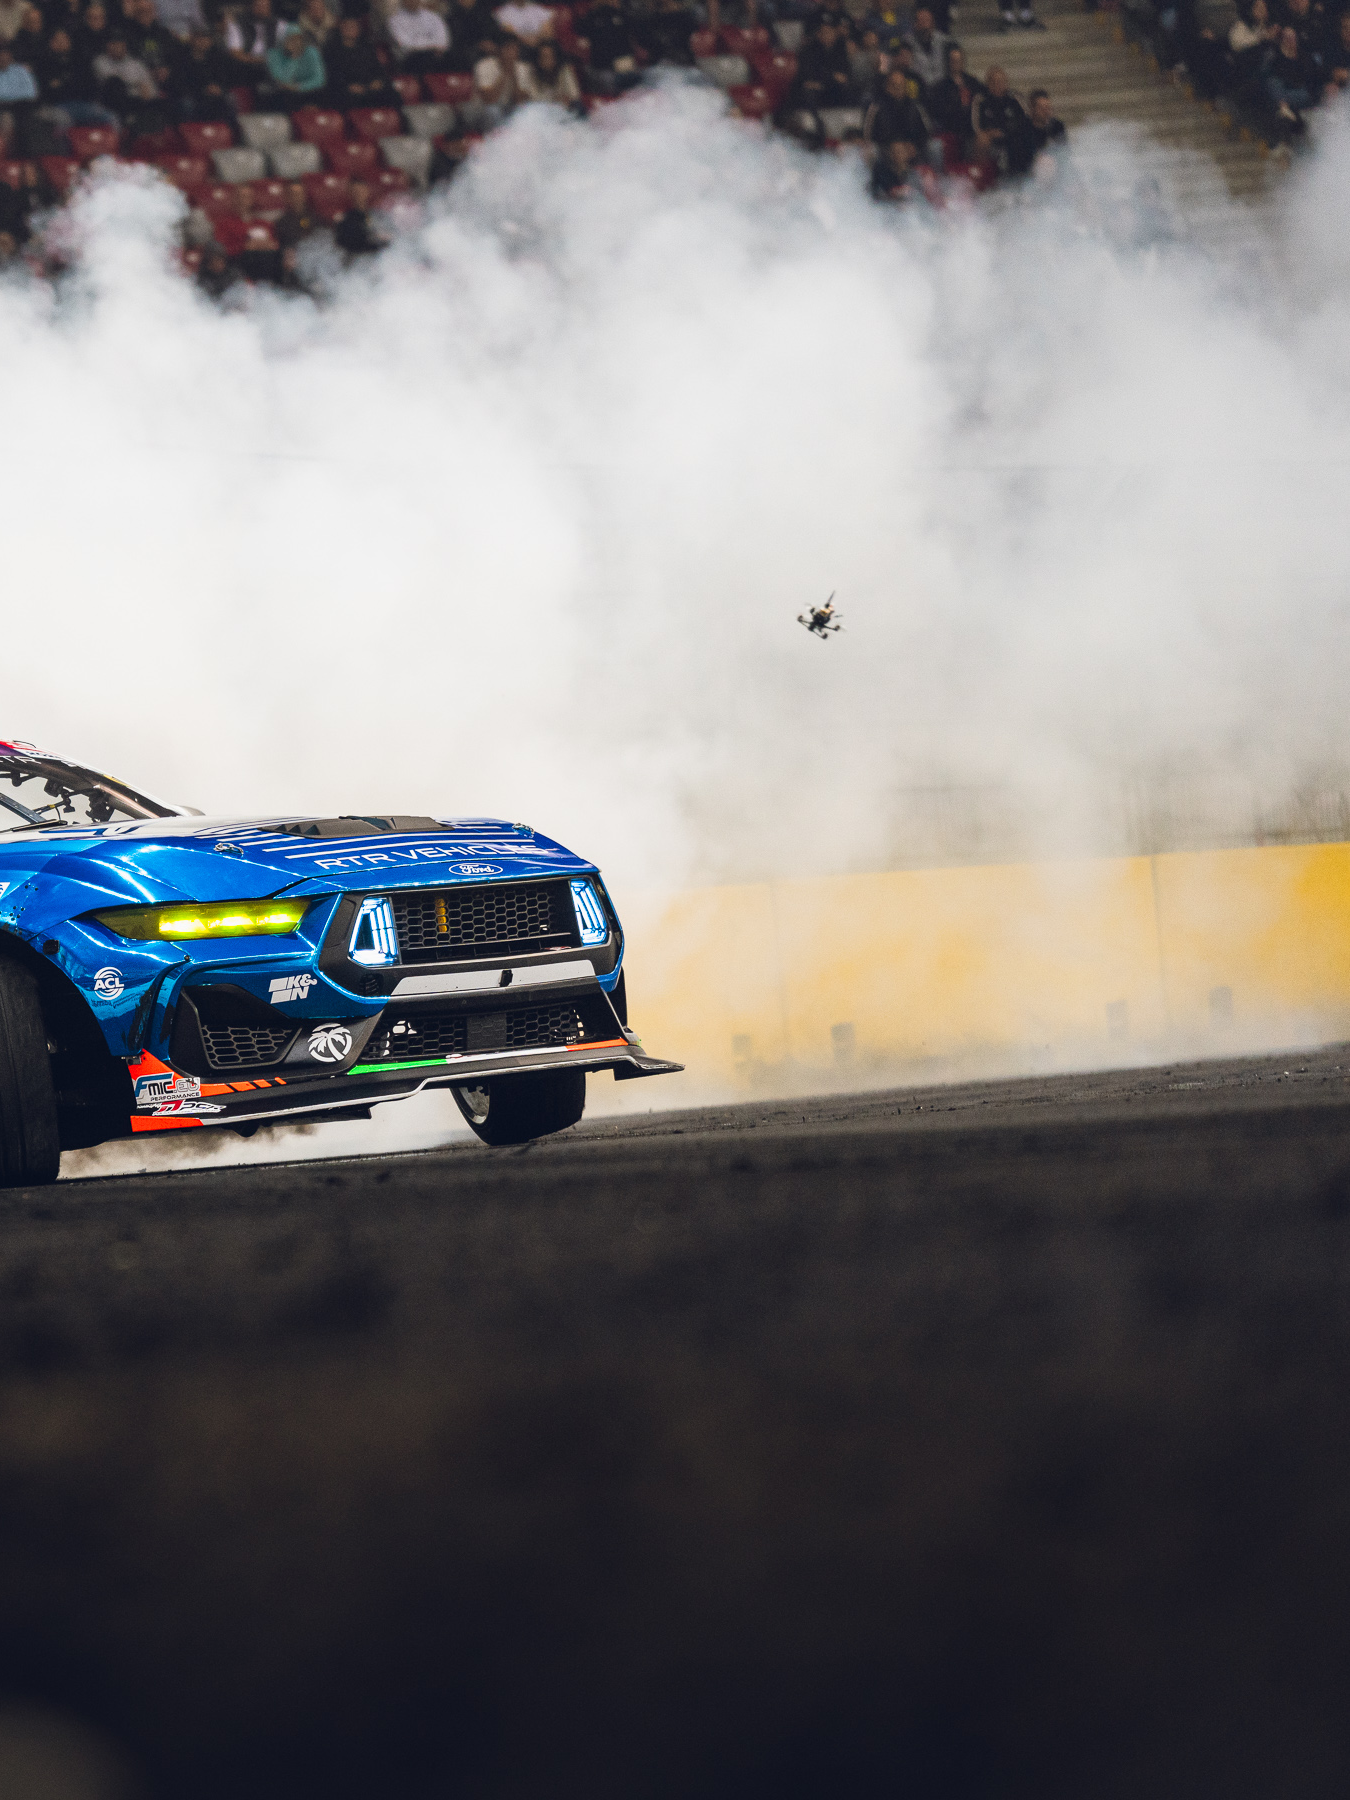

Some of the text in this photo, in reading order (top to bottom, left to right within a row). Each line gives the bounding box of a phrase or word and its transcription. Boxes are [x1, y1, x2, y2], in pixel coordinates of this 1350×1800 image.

[314, 844, 549, 869] RTR VEHICLES
[459, 863, 495, 874] Ford
[93, 978, 124, 991] ACL
[287, 973, 317, 1000] K&N
[150, 1091, 200, 1102] PERFORMANCE
